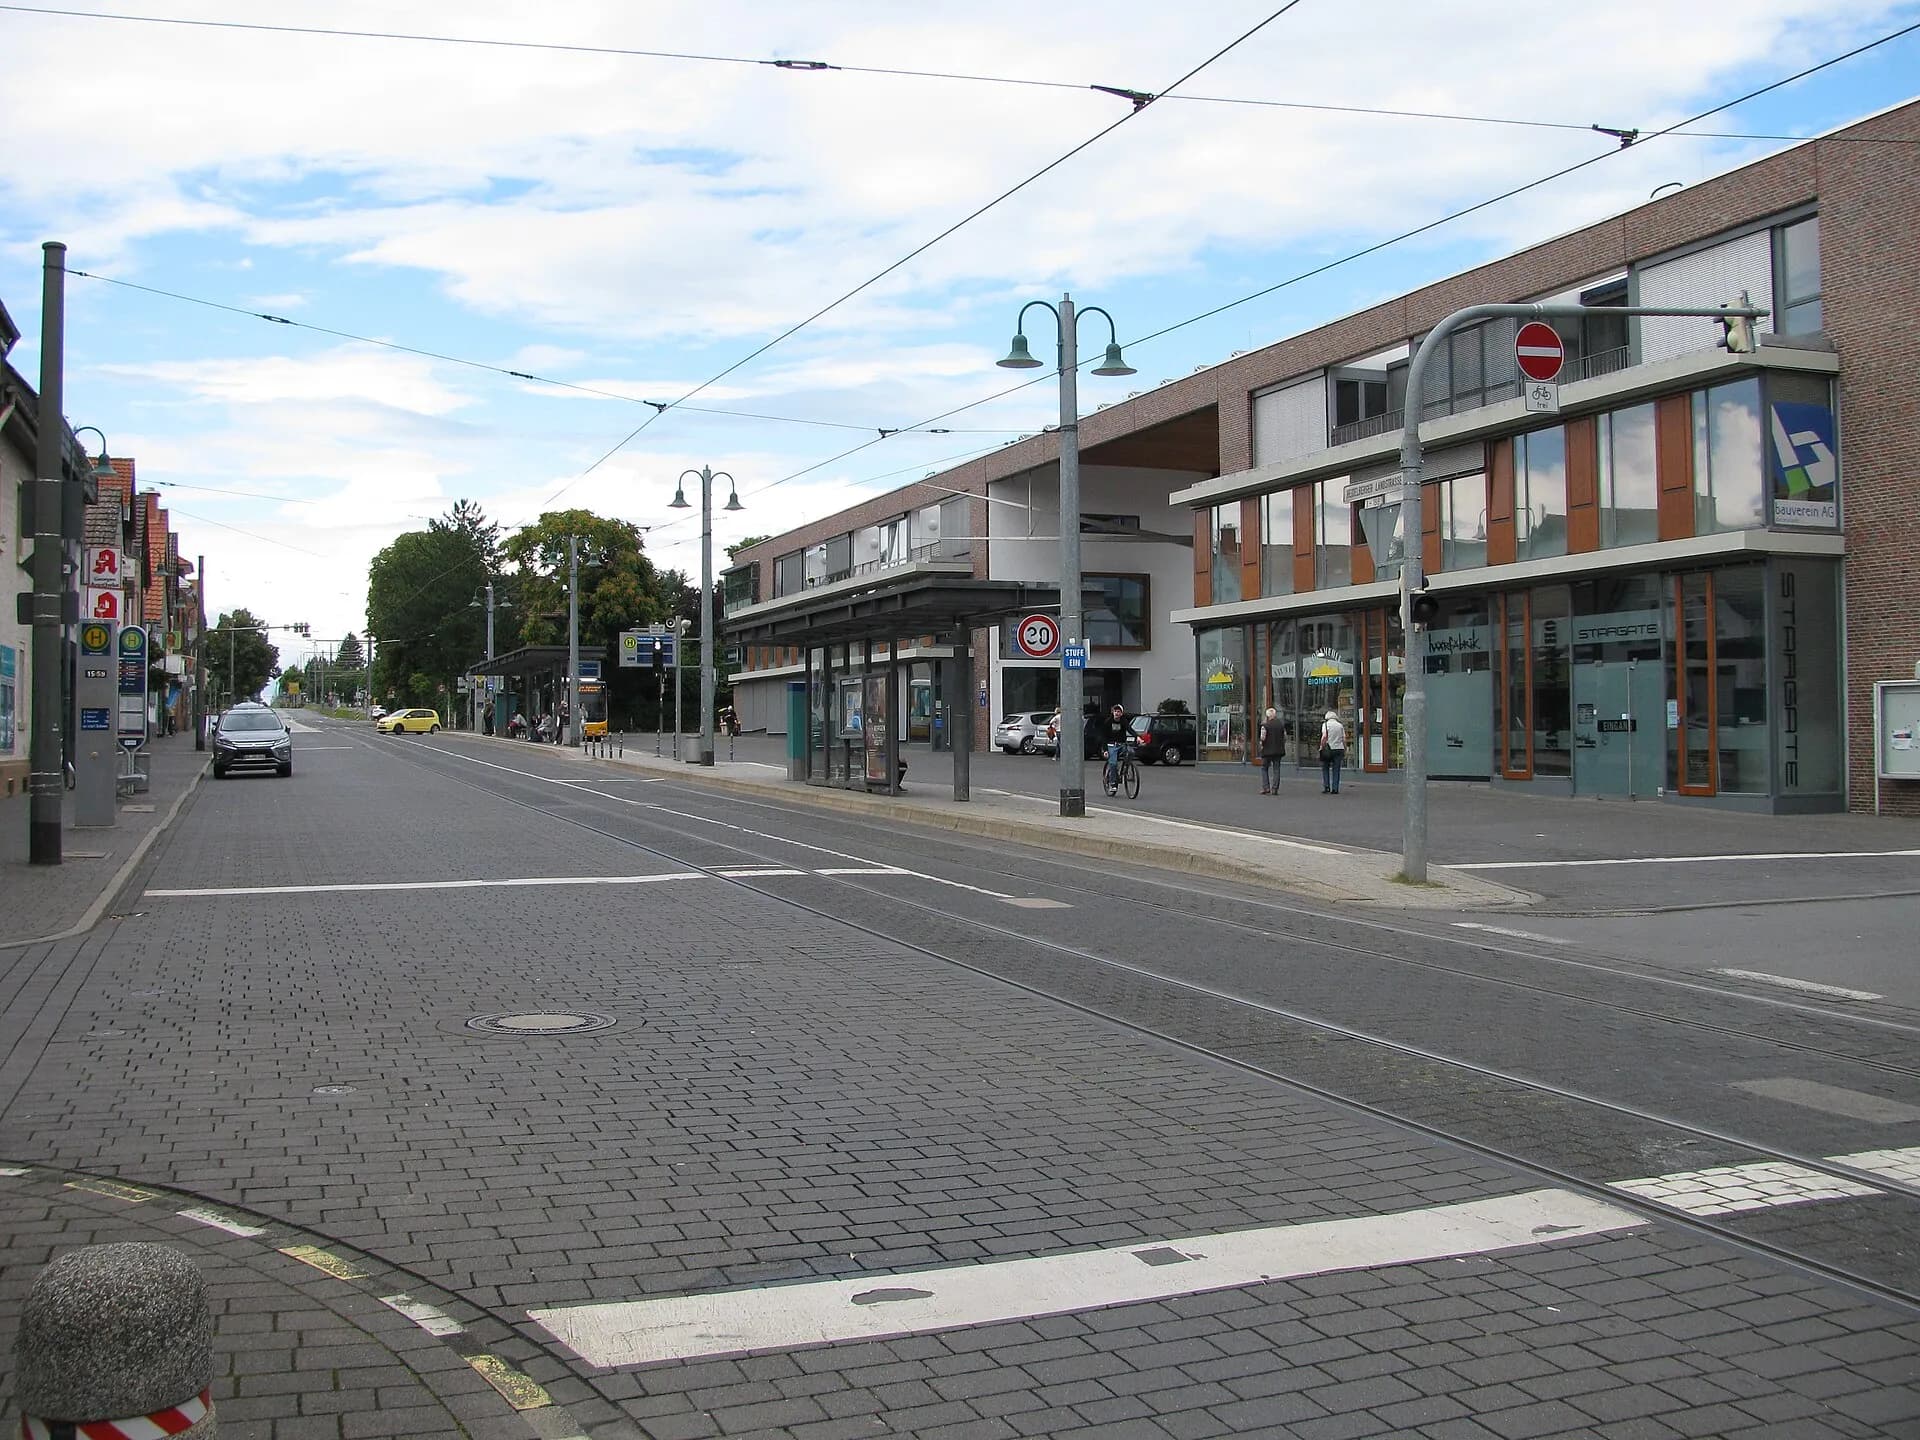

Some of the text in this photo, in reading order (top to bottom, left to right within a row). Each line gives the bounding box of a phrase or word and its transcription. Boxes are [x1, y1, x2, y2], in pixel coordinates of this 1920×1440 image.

[1536, 401, 1549, 409] frei
[1775, 504, 1835, 518] bauverein AG
[90, 630, 102, 644] H
[1027, 627, 1050, 645] 30
[1578, 623, 1658, 640] STARGATE
[1065, 649, 1084, 657] STUFE
[1069, 659, 1081, 667] EIN
[1307, 676, 1342, 685] BIOMARKT
[1781, 572, 1798, 787] STARGATE
